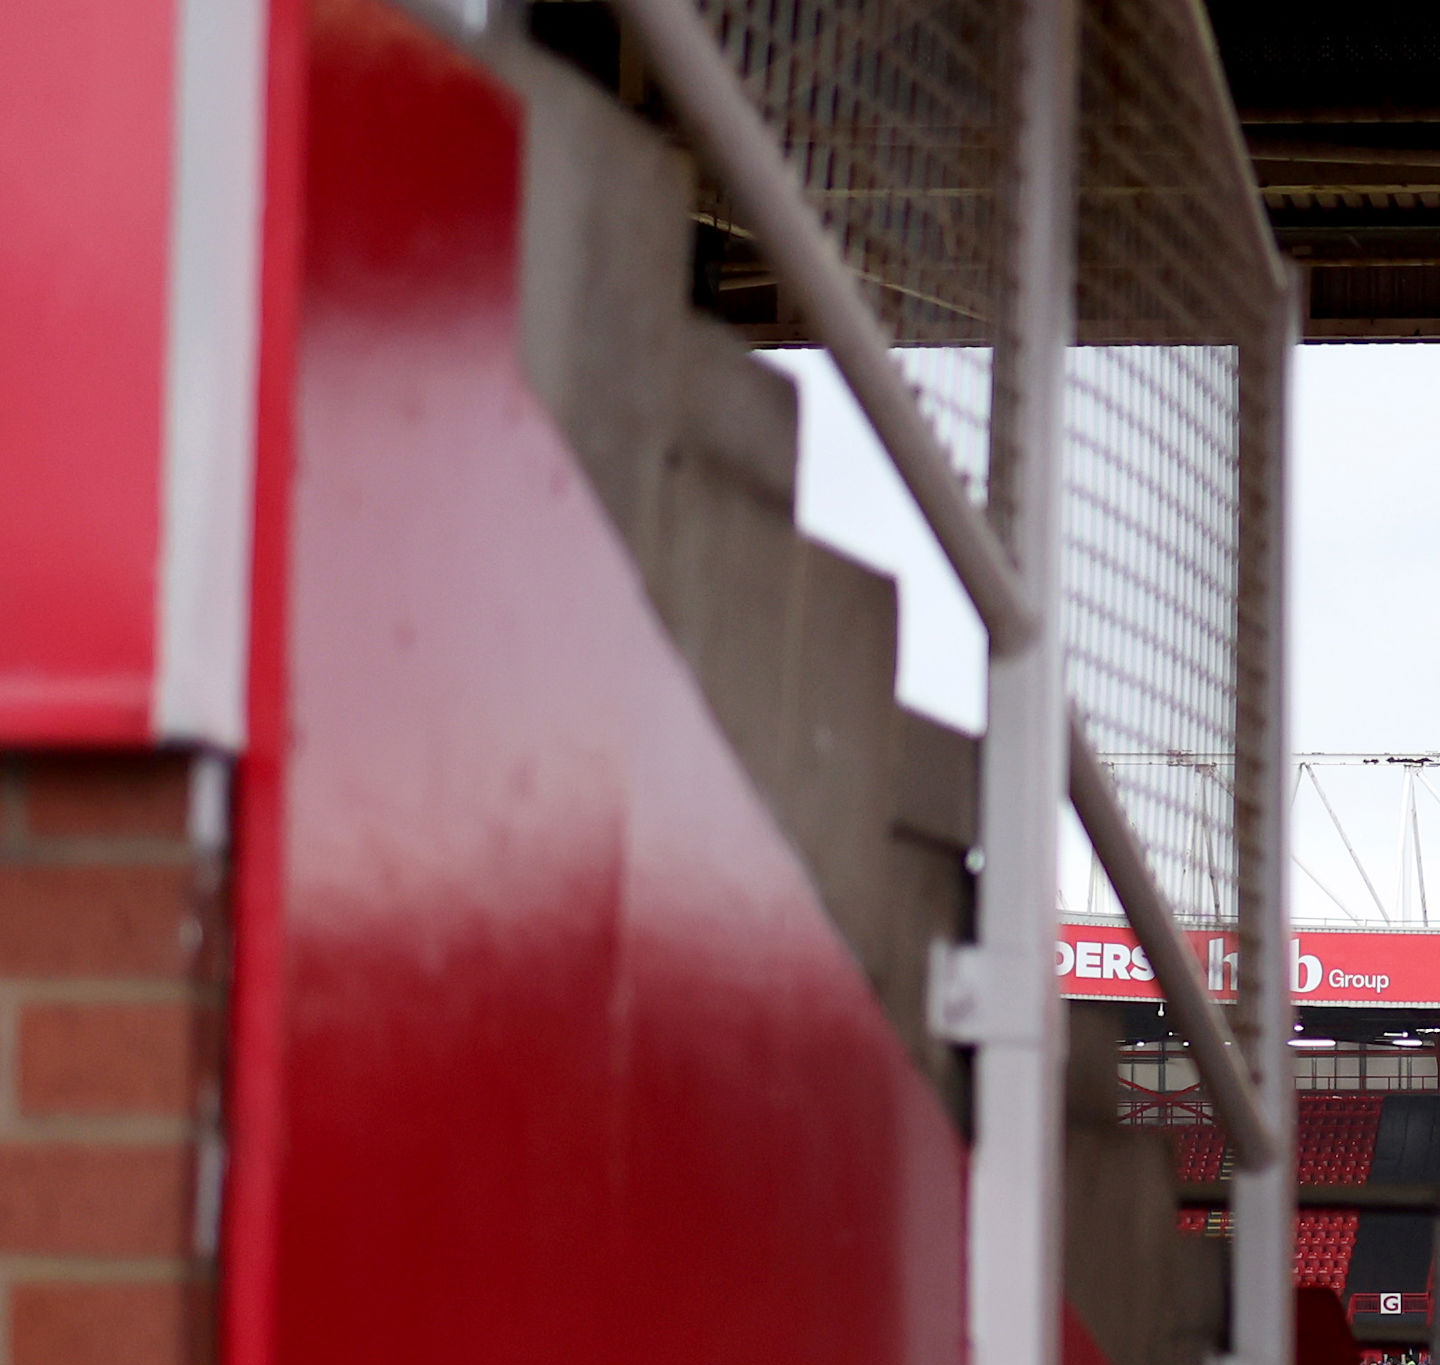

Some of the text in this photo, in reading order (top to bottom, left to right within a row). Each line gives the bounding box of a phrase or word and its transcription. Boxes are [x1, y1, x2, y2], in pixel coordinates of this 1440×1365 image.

[1208, 938, 1390, 993] hb Group
[1383, 1295, 1399, 1311] G
